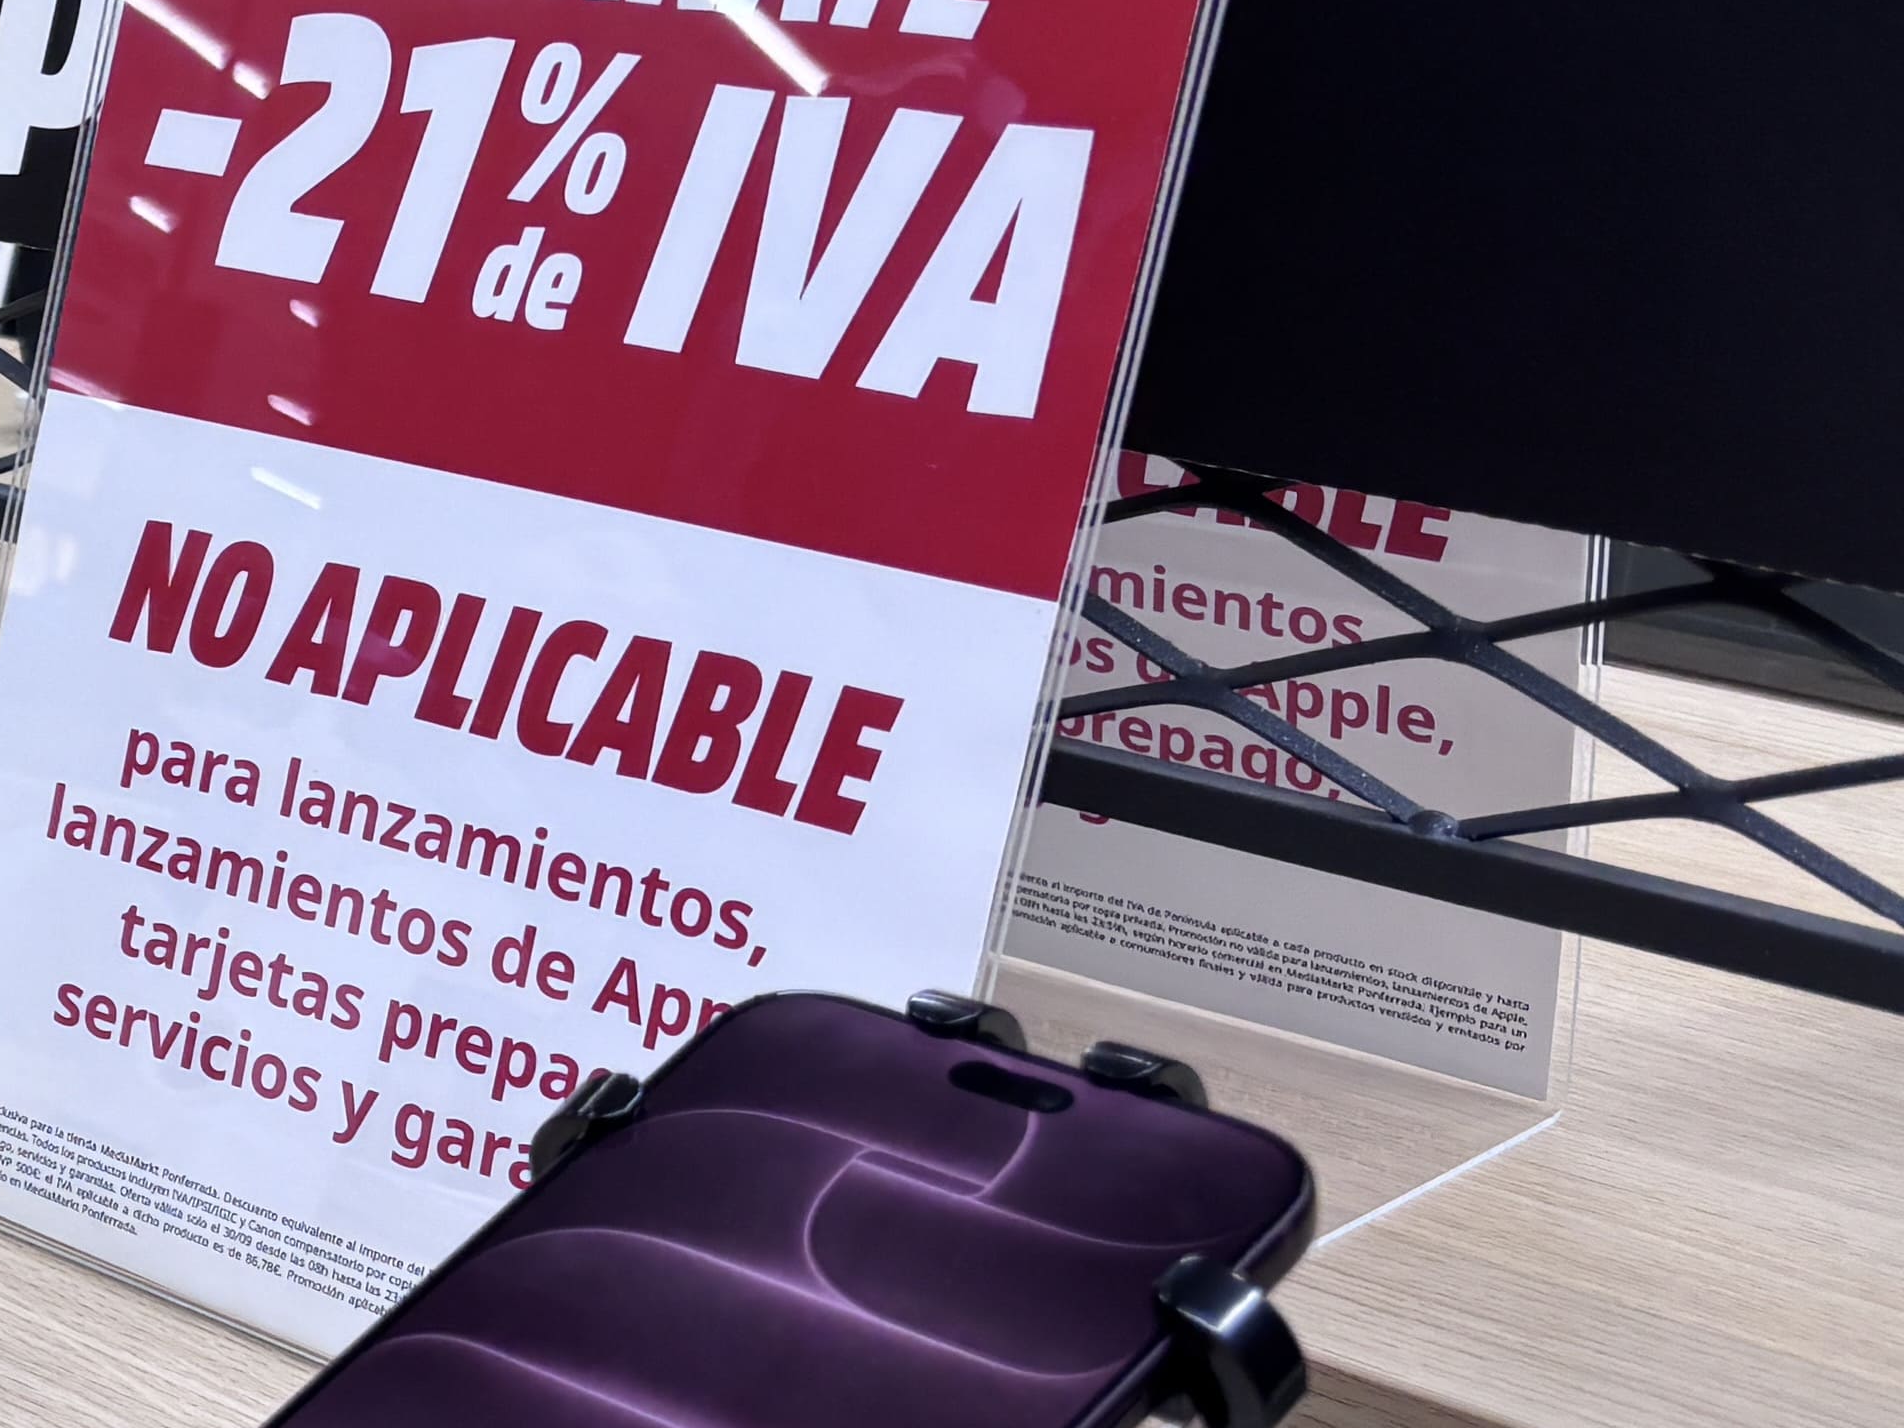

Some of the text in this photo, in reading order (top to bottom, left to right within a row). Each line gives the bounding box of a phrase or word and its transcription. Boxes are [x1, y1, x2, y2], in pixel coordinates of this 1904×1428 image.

[143, 11, 1094, 420] -21% de IVA
[108, 517, 906, 838] NO APLICABLE
[1091, 563, 1365, 647] mientos
[45, 781, 469, 971] lanzamientos
[490, 922, 578, 1002] de
[119, 725, 771, 971] para lanzamientos,
[51, 978, 533, 1190] servicios y gara
[119, 903, 613, 1101] tarjetas prepa
[17, 1147, 57, 1170] servicios
[120, 1186, 151, 1206] Oferta
[223, 1226, 252, 1246] 30/09
[256, 1241, 287, 1260] desde
[290, 1252, 305, 1267] las
[332, 1268, 362, 1290] hasta
[30, 1119, 53, 1134] para
[54, 1127, 64, 1139] la
[67, 1133, 97, 1151] tienda
[162, 1168, 220, 1199] Ponferrada.
[223, 1192, 278, 1222] Descuento
[281, 1217, 343, 1247] equivalente
[346, 1240, 357, 1252] al
[407, 1263, 425, 1280] del
[32, 1134, 59, 1154] Todos
[61, 1146, 75, 1160] los
[77, 1154, 126, 1180] productos
[248, 1219, 281, 1241] Canon
[284, 1235, 364, 1272] compensatorio
[366, 1266, 386, 1280] por
[57, 1177, 72, 1192] IVA
[163, 1222, 209, 1247] producto
[228, 1247, 242, 1260] de
[287, 1270, 344, 1300] Promoción
